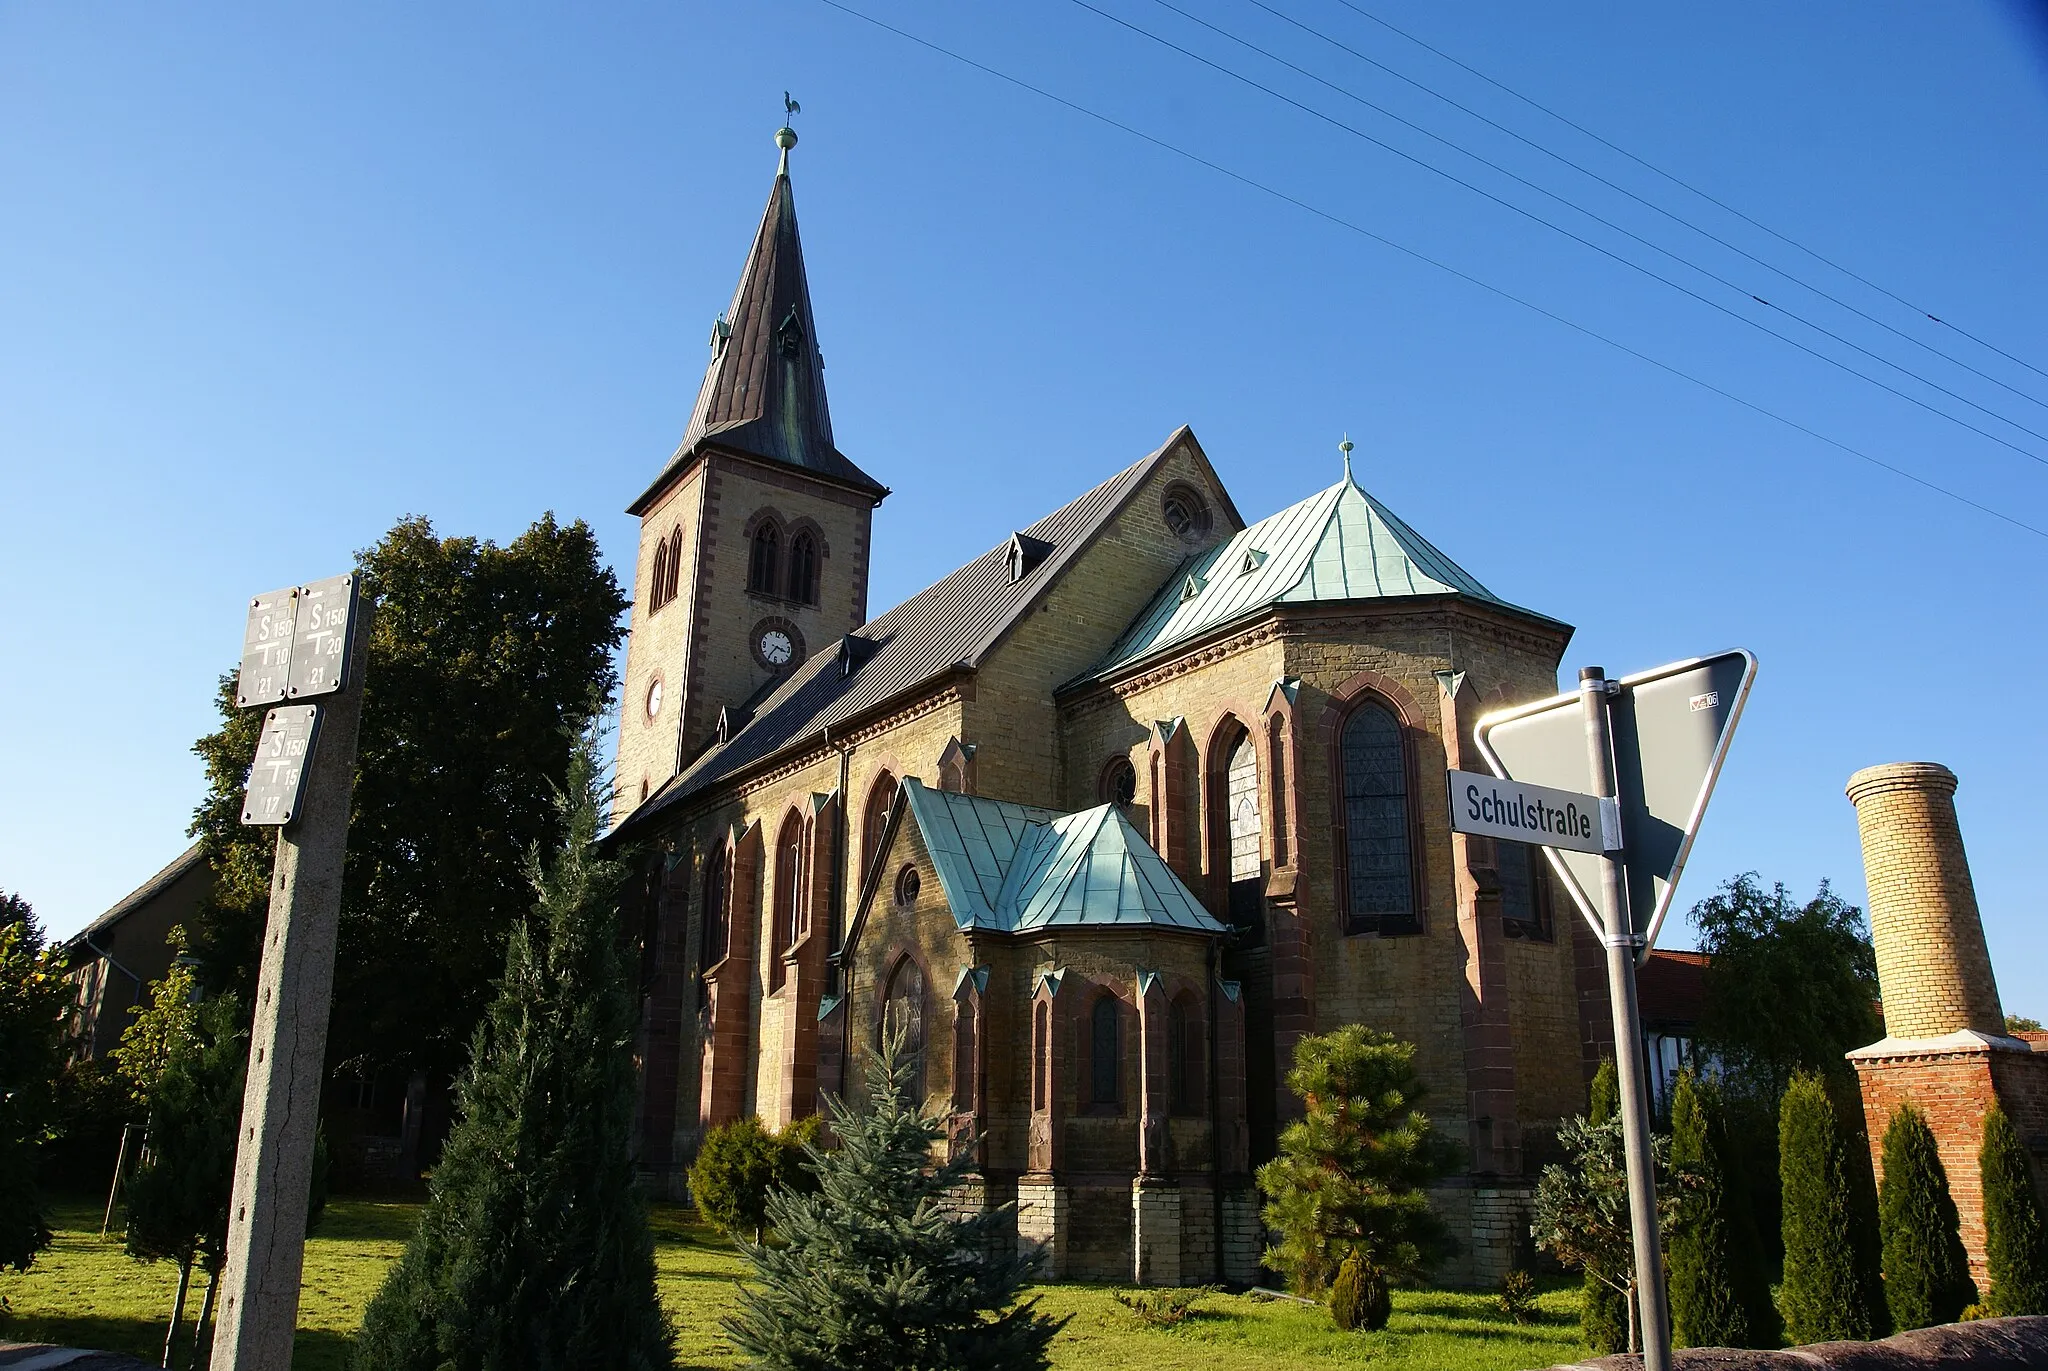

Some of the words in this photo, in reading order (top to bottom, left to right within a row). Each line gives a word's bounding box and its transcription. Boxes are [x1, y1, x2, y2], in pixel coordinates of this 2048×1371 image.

[259, 615, 271, 640] S
[273, 619, 294, 638] 150
[310, 602, 323, 630] S
[325, 607, 346, 627] 150
[255, 641, 280, 665] T
[275, 648, 289, 665] 10
[306, 629, 333, 655] T
[327, 636, 342, 655] 20
[258, 677, 272, 695] 21
[310, 666, 324, 685] 21
[271, 730, 285, 758] S
[285, 739, 305, 757] 150
[266, 760, 292, 784] T
[284, 768, 299, 786] 15
[265, 796, 280, 813] 17
[1466, 785, 1591, 839] Schulstraße
